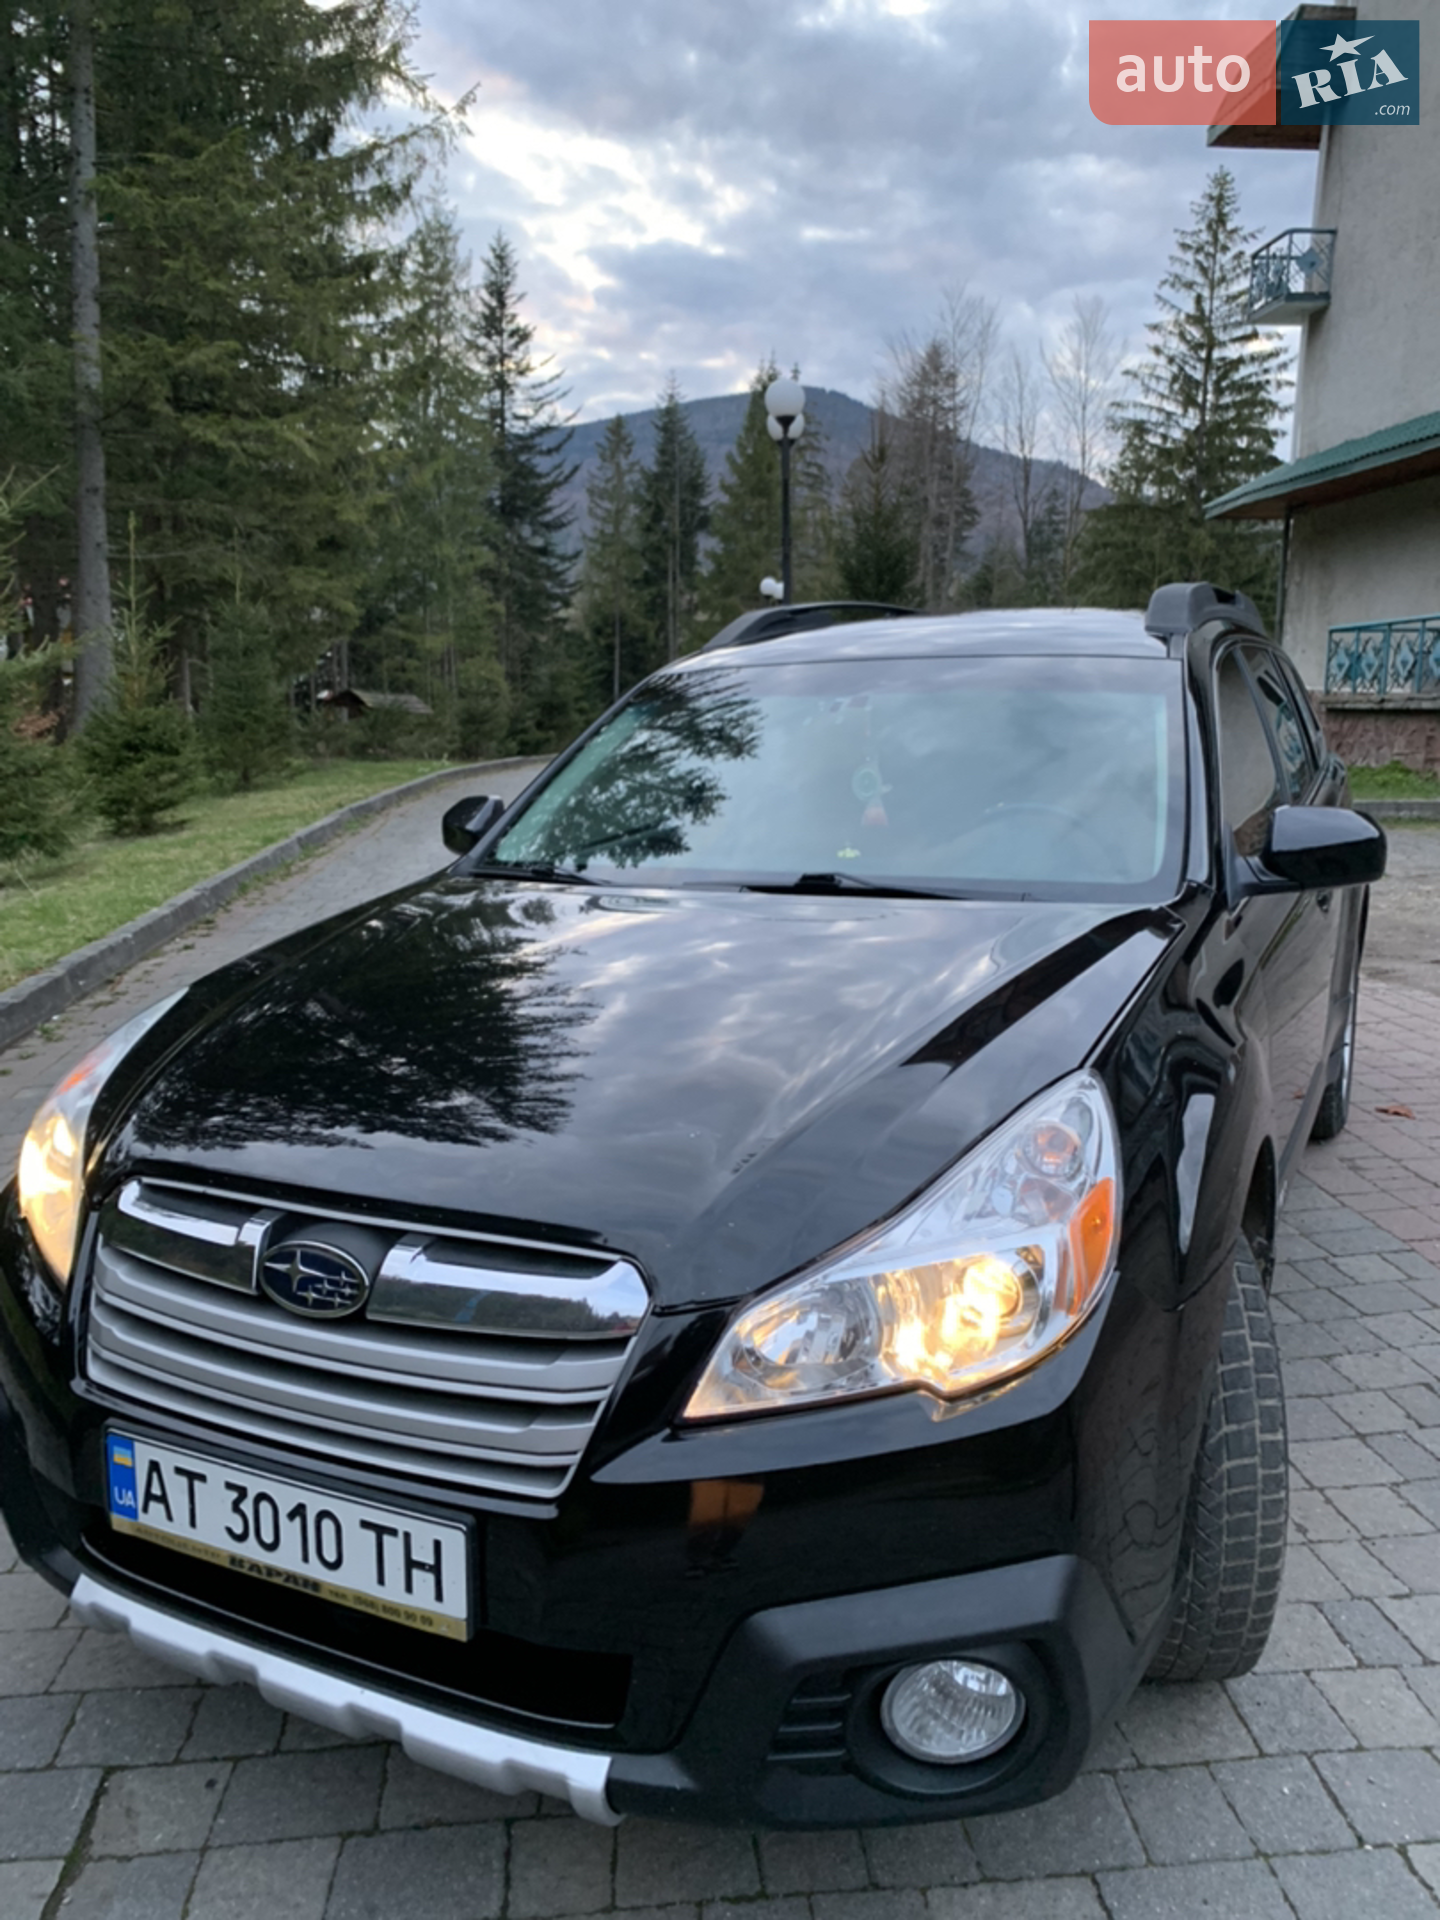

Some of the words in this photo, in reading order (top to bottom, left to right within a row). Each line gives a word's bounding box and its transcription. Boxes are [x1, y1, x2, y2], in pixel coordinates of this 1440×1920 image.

[113, 1486, 136, 1509] UA
[141, 1459, 207, 1530] AT
[224, 1481, 343, 1571] 3010
[359, 1519, 444, 1603] TH
